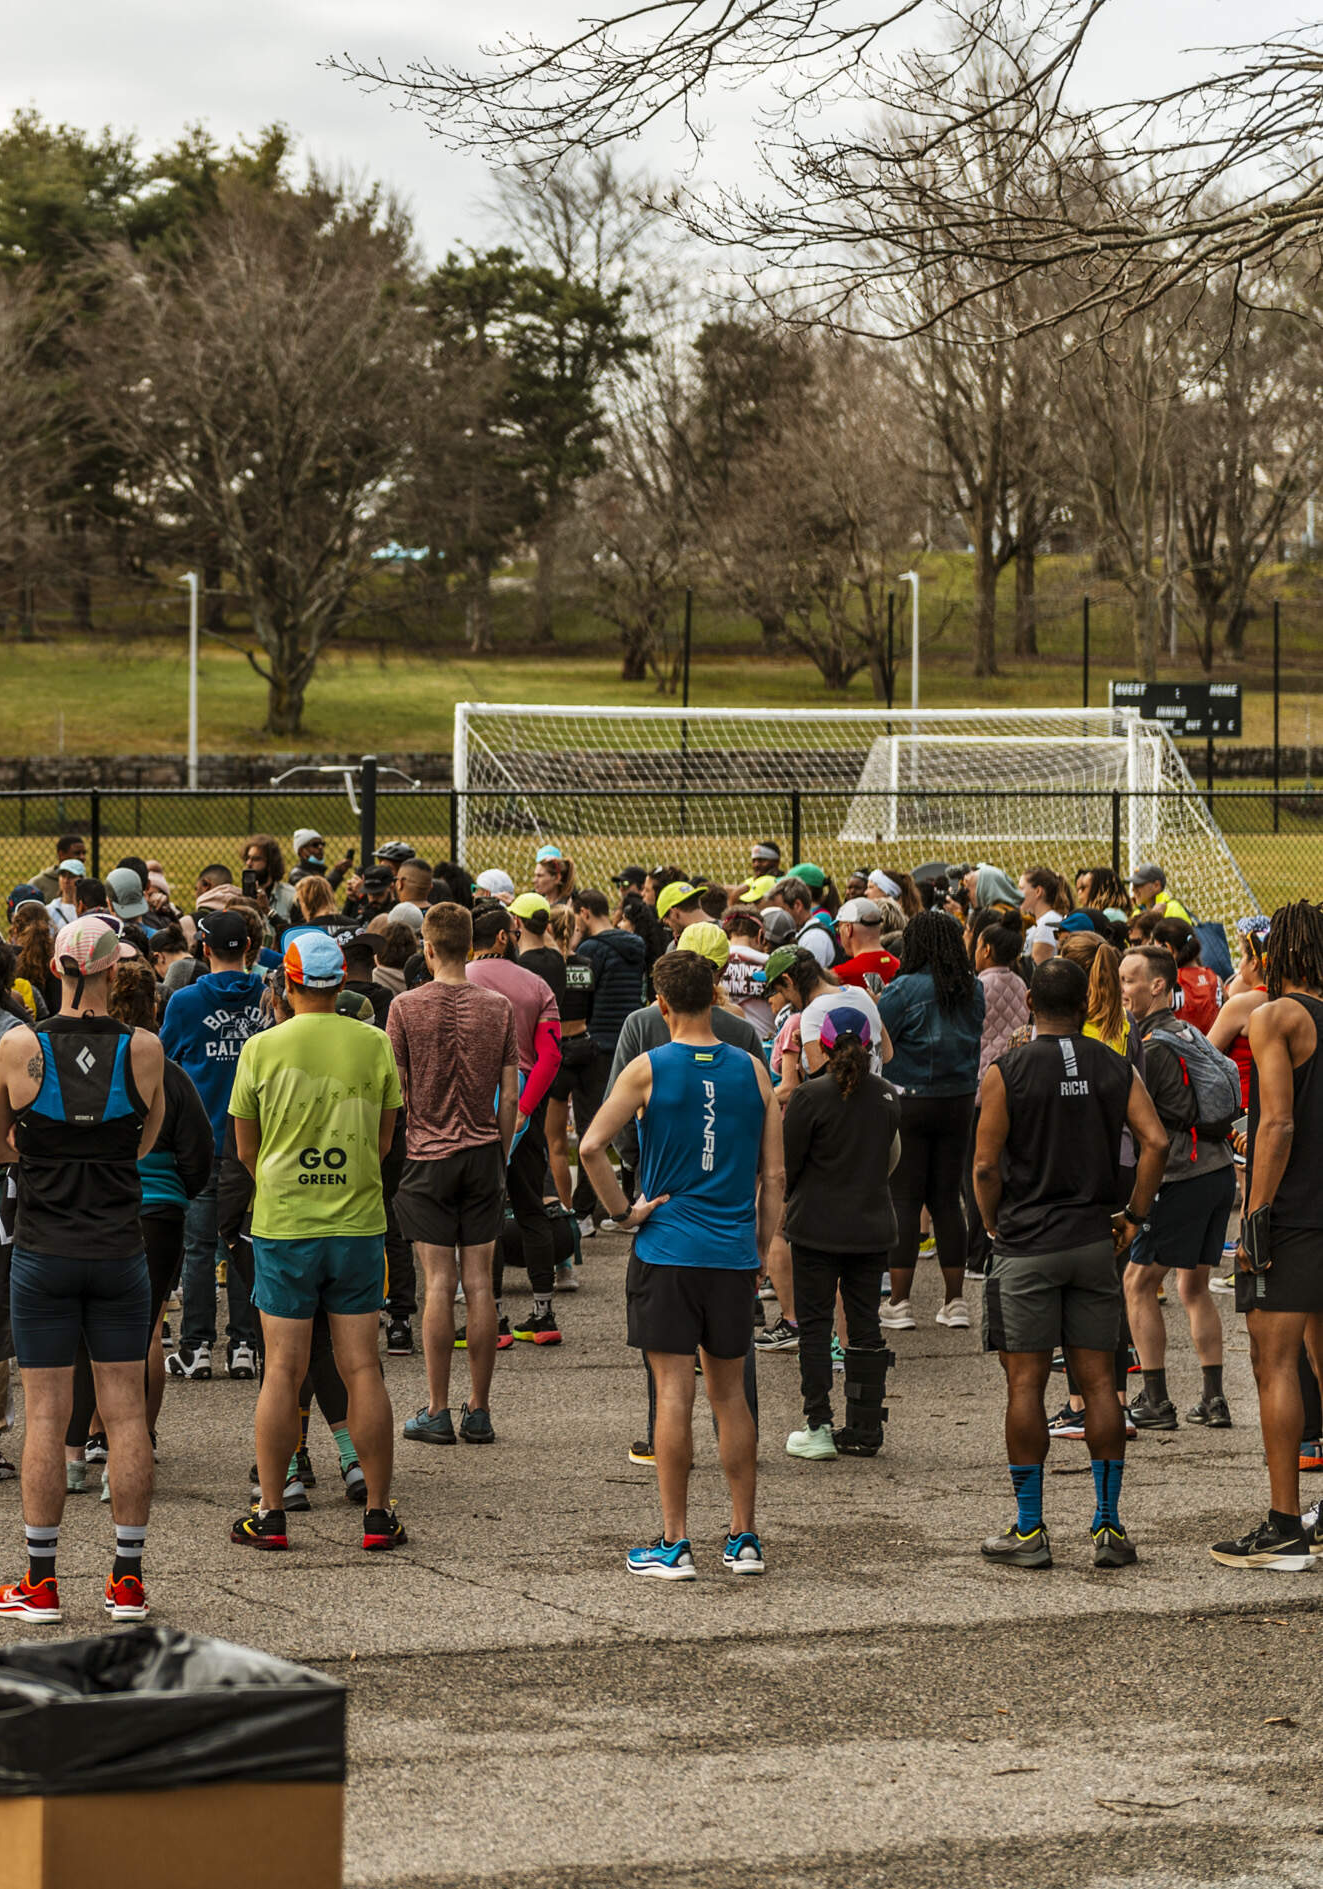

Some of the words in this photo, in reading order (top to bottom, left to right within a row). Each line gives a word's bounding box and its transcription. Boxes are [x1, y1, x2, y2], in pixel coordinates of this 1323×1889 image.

[1209, 684, 1238, 697] HOME
[1060, 1080, 1089, 1096] RICH
[701, 1080, 715, 1172] PYNRS
[299, 1147, 347, 1170] GO
[298, 1173, 347, 1185] GREEN
